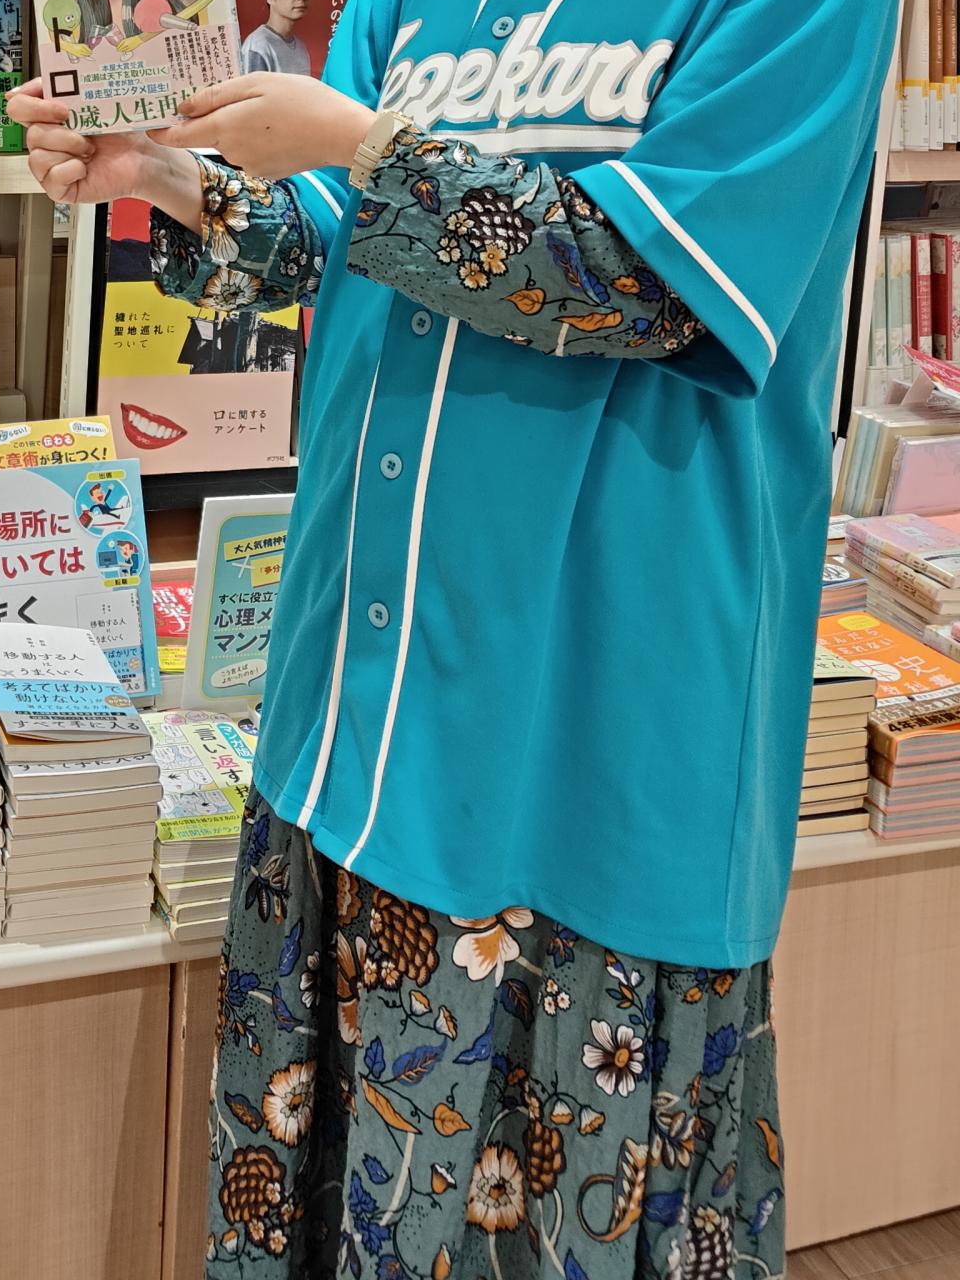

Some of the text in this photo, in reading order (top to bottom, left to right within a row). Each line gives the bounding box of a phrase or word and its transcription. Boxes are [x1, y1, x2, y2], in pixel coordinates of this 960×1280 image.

[84, 83, 170, 100] 爆走型エンタメ誕生!
[113, 324, 175, 337] 聖地巡礼に
[113, 339, 148, 350] ついて
[214, 408, 268, 421] 口に関する
[214, 423, 267, 435] アンケート
[2, 650, 87, 662] 移動する人
